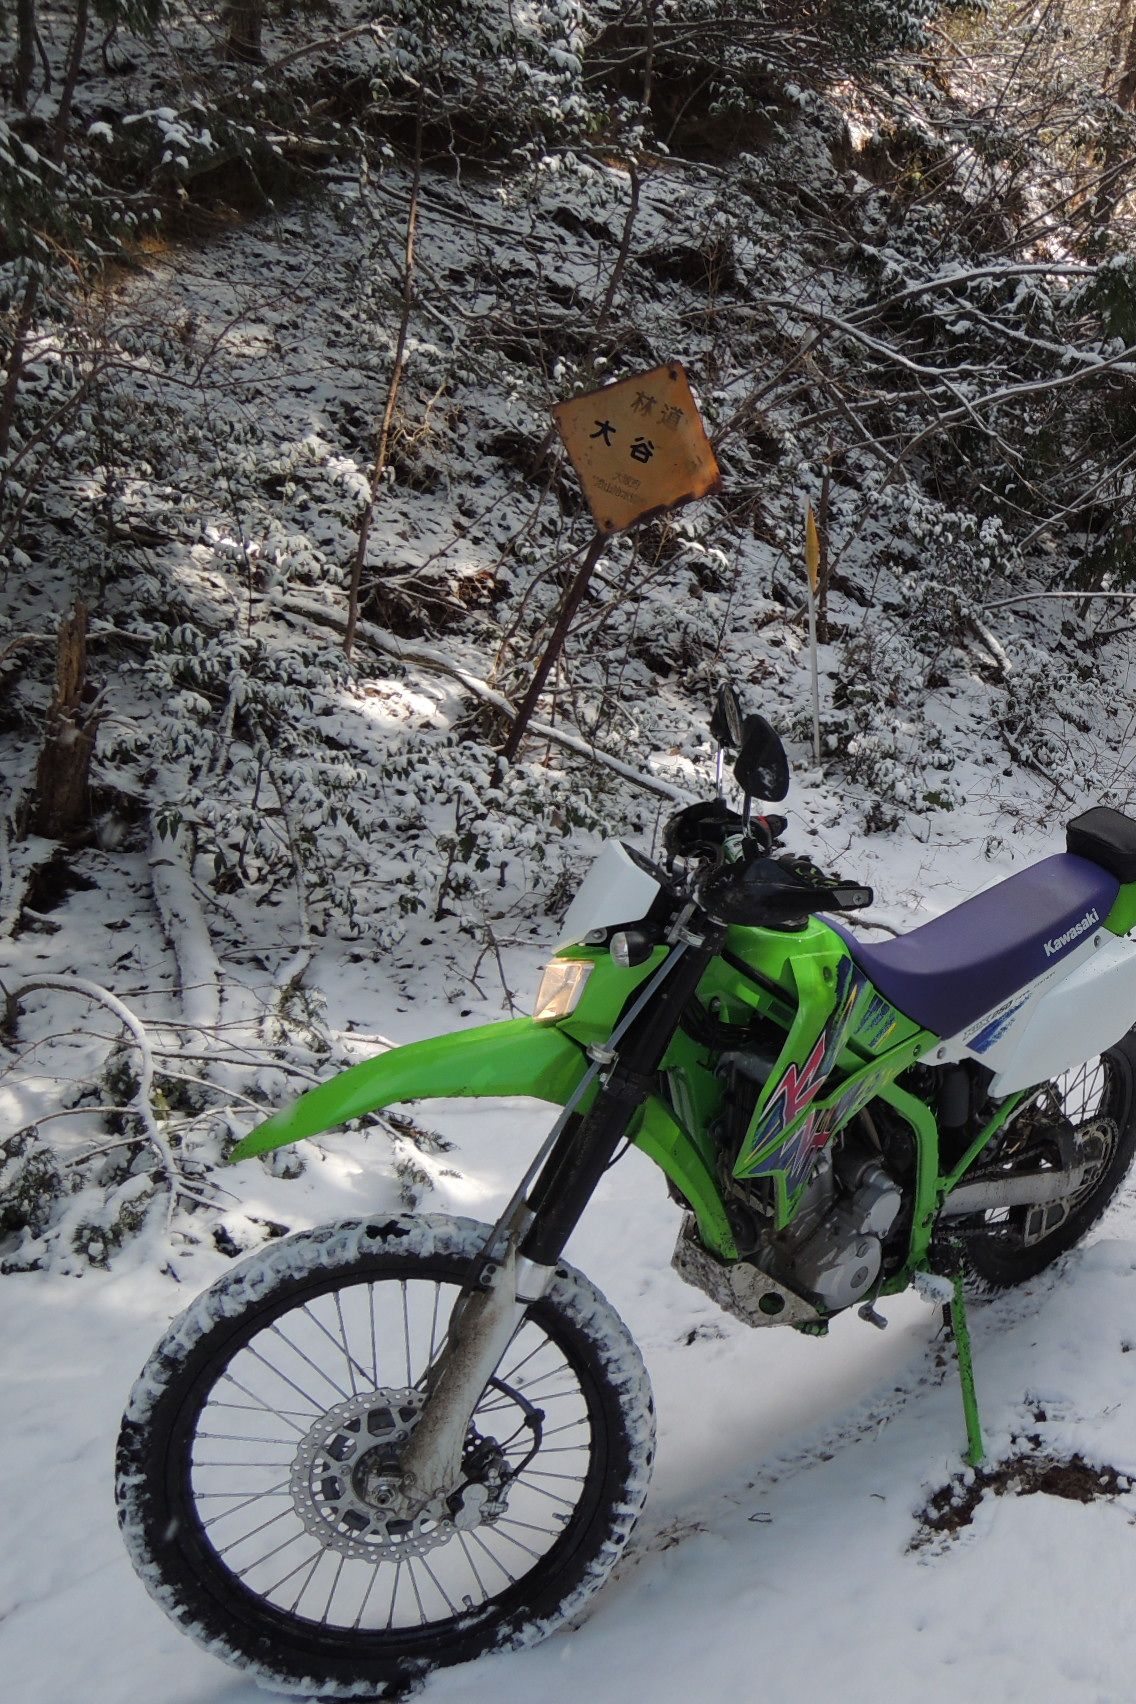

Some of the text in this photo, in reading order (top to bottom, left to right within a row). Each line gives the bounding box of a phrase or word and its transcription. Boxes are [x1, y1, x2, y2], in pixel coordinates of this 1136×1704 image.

[630, 391, 684, 431] 林道
[589, 420, 655, 464] 大谷
[1043, 907, 1100, 957] Kawasaki
